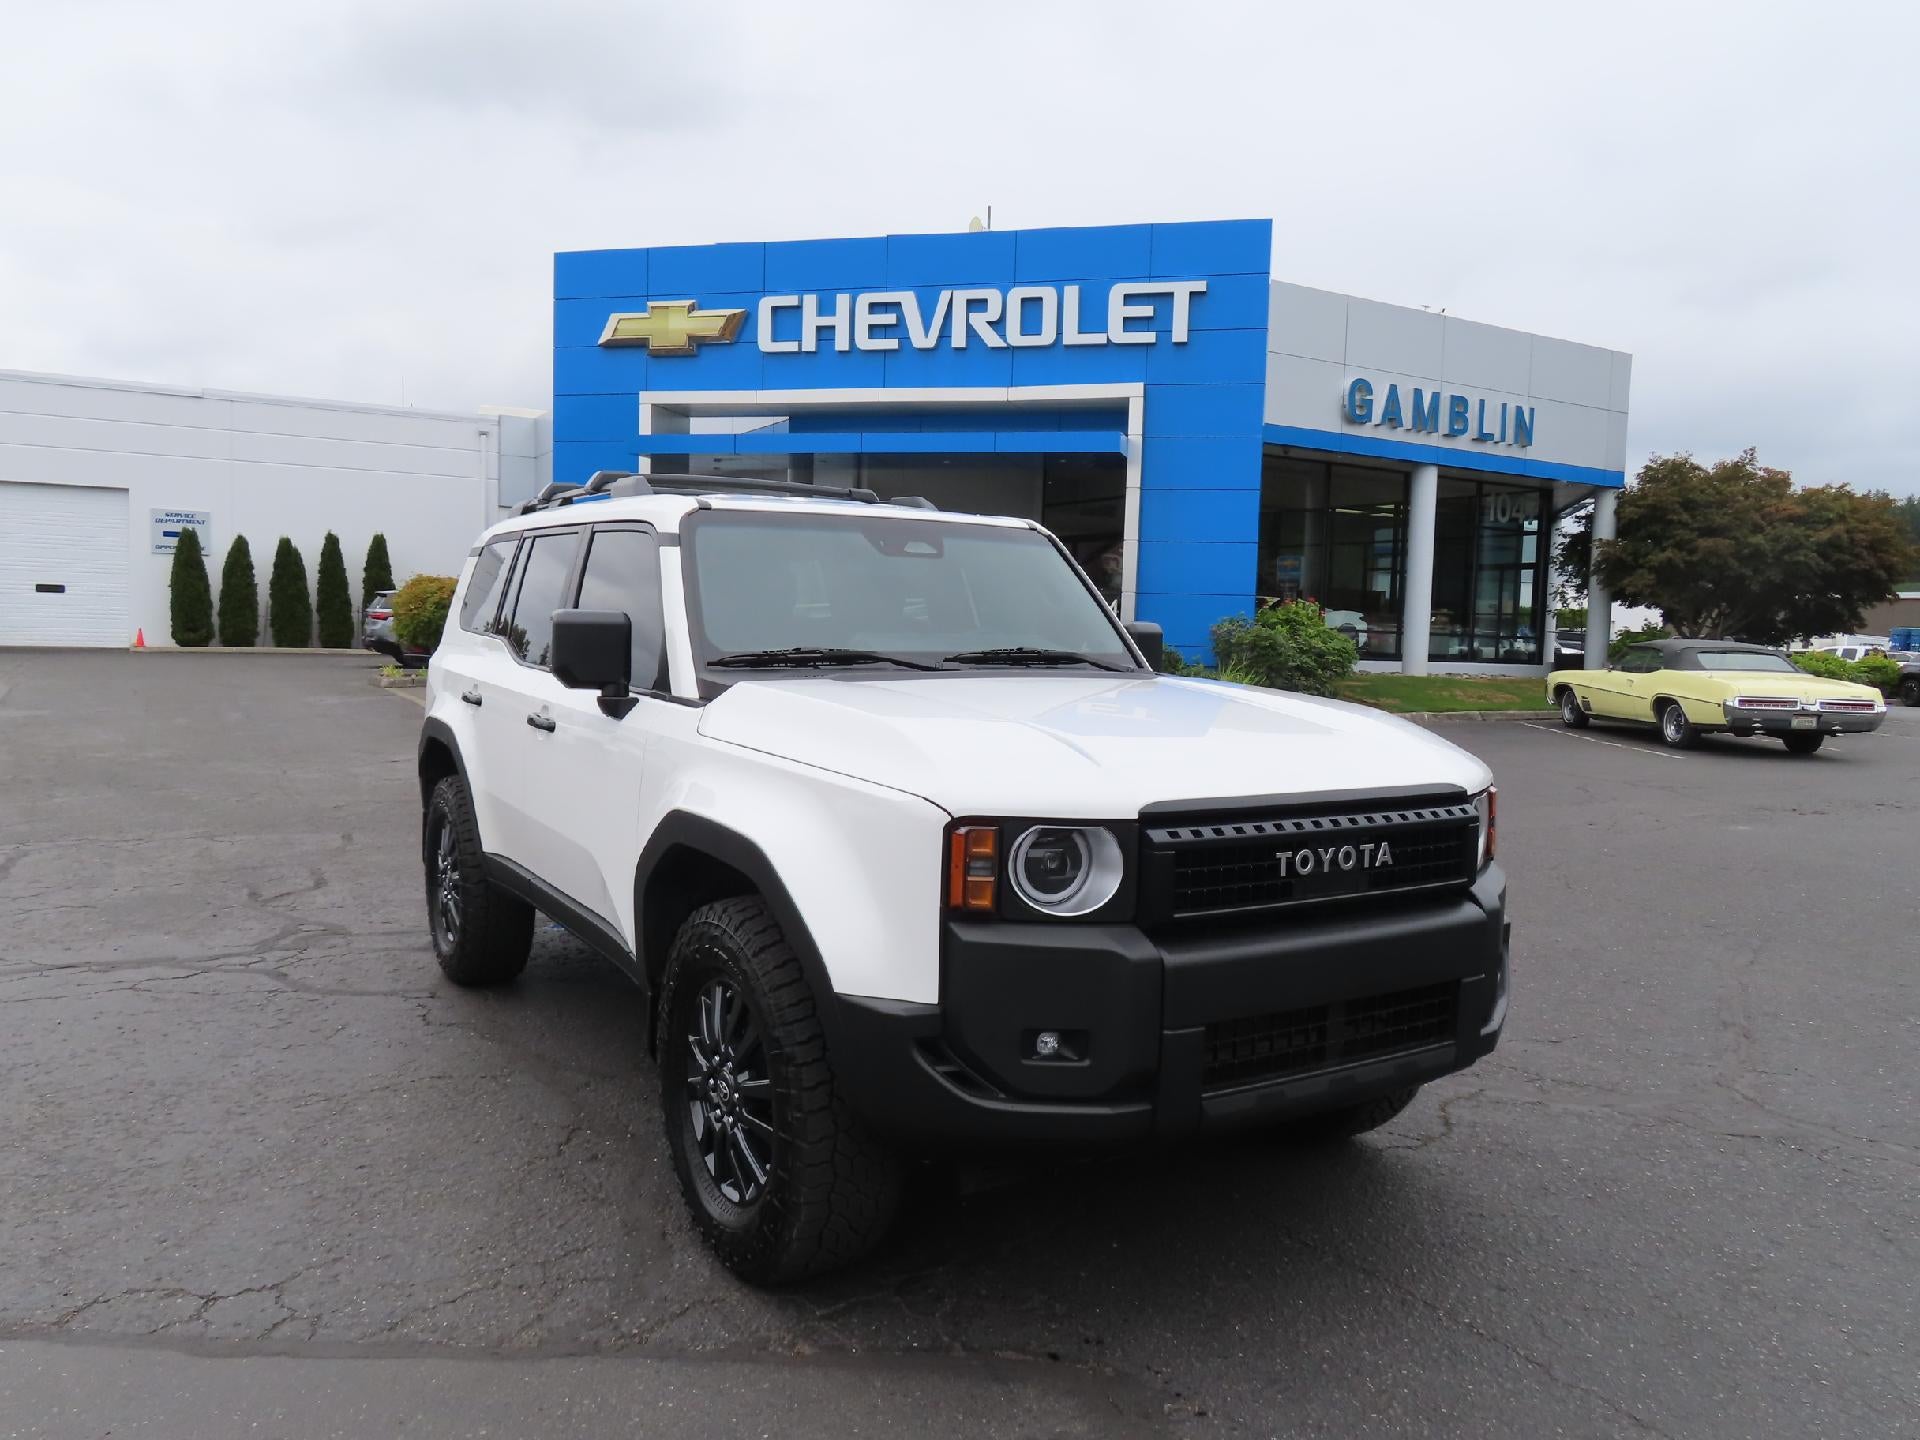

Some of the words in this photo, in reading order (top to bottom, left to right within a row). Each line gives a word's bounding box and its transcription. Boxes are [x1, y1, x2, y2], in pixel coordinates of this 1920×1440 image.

[757, 280, 1207, 353] CHEVROLET
[1346, 377, 1535, 448] GAMBLIN
[1275, 841, 1393, 877] TOYOTA
